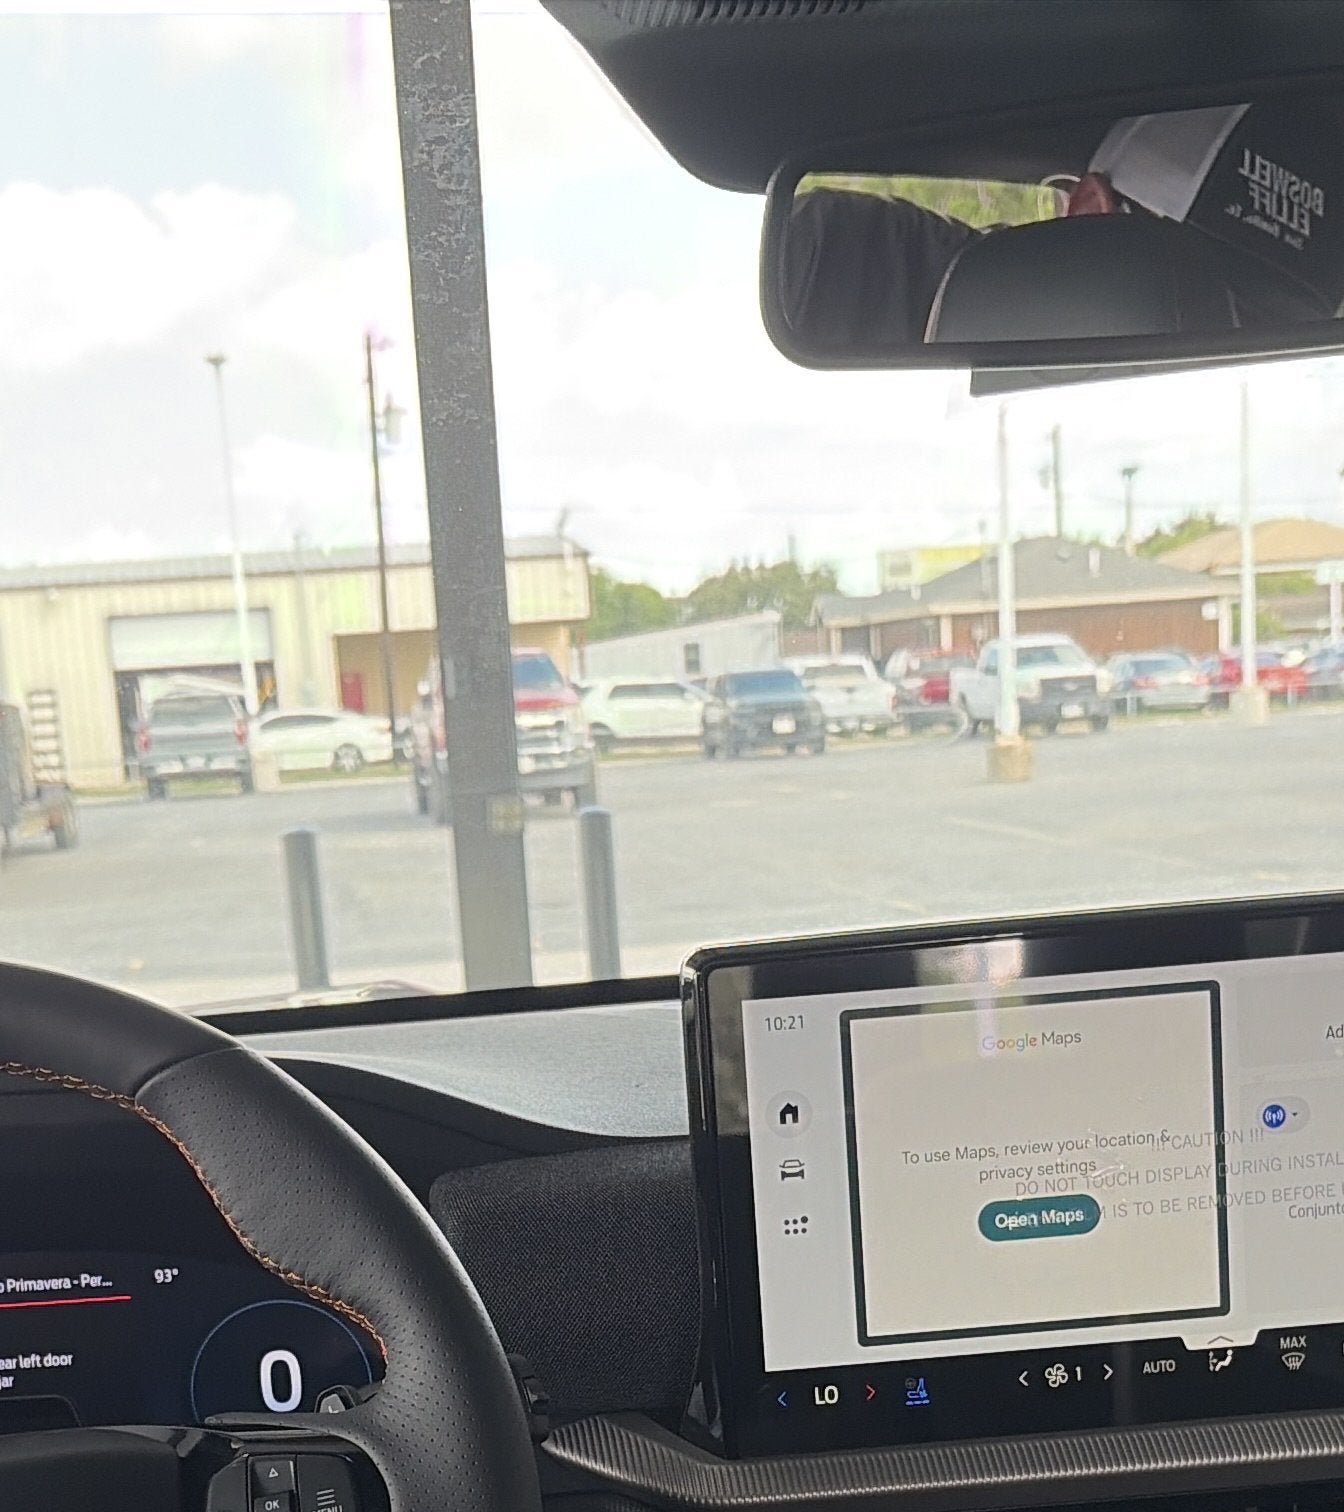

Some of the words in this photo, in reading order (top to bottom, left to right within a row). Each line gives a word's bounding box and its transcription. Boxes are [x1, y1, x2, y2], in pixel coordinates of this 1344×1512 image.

[764, 1015, 805, 1032] 10:21
[981, 1033, 1037, 1052] Google
[1041, 1031, 1082, 1048] Maps
[902, 1151, 920, 1165] To
[924, 1149, 951, 1163] use
[955, 1146, 1000, 1161] Maps,
[1004, 1140, 1054, 1156] review
[1057, 1139, 1091, 1155] your
[1095, 1130, 1154, 1149] location
[1160, 1128, 1171, 1143] &
[1171, 1129, 1244, 1151] CAUTION
[979, 1165, 1033, 1184] privacy
[1037, 1159, 1097, 1177] settings
[1015, 1181, 1039, 1197] DO
[1044, 1176, 1078, 1194] NOT
[1083, 1171, 1140, 1191] TOUCH
[1145, 1164, 1213, 1185] DISPLAY
[1217, 1157, 1283, 1178] DURING
[1113, 1203, 1129, 1219] IS
[1135, 1200, 1155, 1217] TO
[1160, 1199, 1183, 1215] BE
[1186, 1190, 1266, 1212] REMOVED
[1271, 1183, 1337, 1205] BEFORE
[994, 1211, 1039, 1231] Open
[1041, 1207, 1086, 1227] Maps
[6, 1278, 72, 1294] Primavera
[80, 1274, 113, 1289] Per...
[1279, 1335, 1307, 1350] MAX
[19, 1354, 43, 1369] left
[44, 1353, 74, 1367] door
[1142, 1359, 1176, 1375] AUTO
[259, 1349, 302, 1413] 0
[814, 1384, 839, 1406] LO
[264, 1500, 280, 1511] OK
